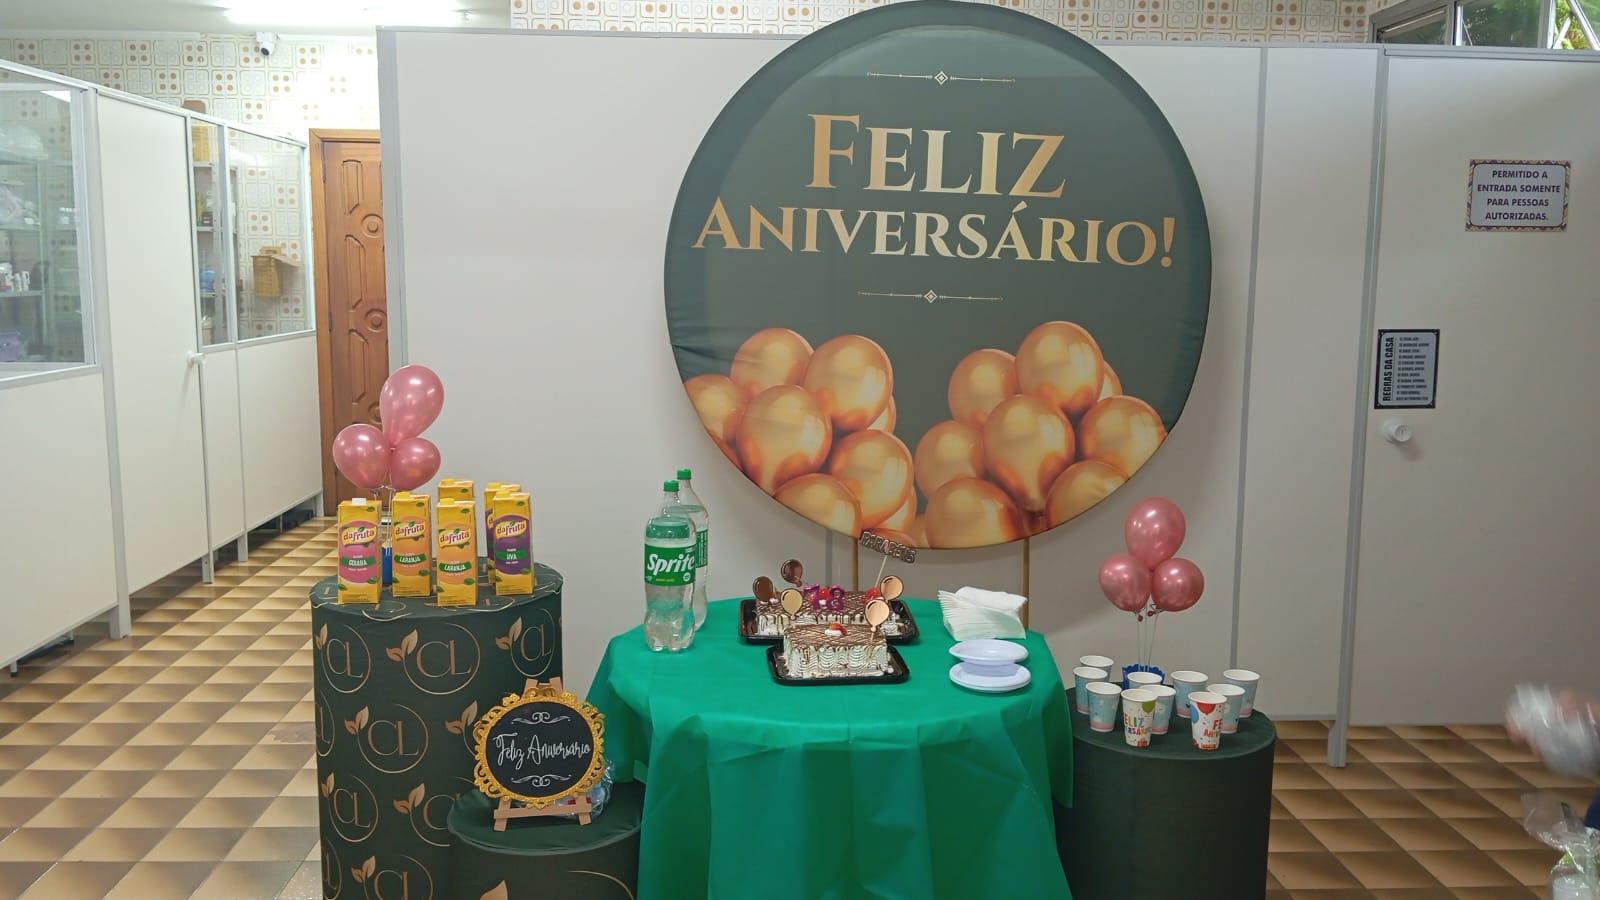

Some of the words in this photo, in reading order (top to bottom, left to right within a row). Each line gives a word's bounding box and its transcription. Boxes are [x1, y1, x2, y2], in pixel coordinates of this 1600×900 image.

[804, 113, 1067, 198] FELIZ
[1492, 170, 1539, 179] PERMITIDO
[1541, 171, 1548, 179] A
[1477, 184, 1517, 192] ENTRADA
[1519, 184, 1561, 193] SOMENTE
[1487, 198, 1509, 206] PARA
[1511, 198, 1549, 207] PESSOAS
[1485, 212, 1549, 220] AUTORIZADAS.
[690, 195, 1176, 268] ANIVERSÁRIO!
[1385, 337, 1394, 358] CASA
[1384, 359, 1393, 370] DA
[1383, 371, 1393, 401] REGRAS
[343, 528, 375, 541] dafruta
[395, 524, 424, 536] dafruta
[497, 522, 525, 535] dafruta
[440, 531, 469, 544] dafruta
[444, 563, 466, 571] LARANJA
[647, 553, 695, 576] Sprite
[492, 732, 525, 770] Feliz
